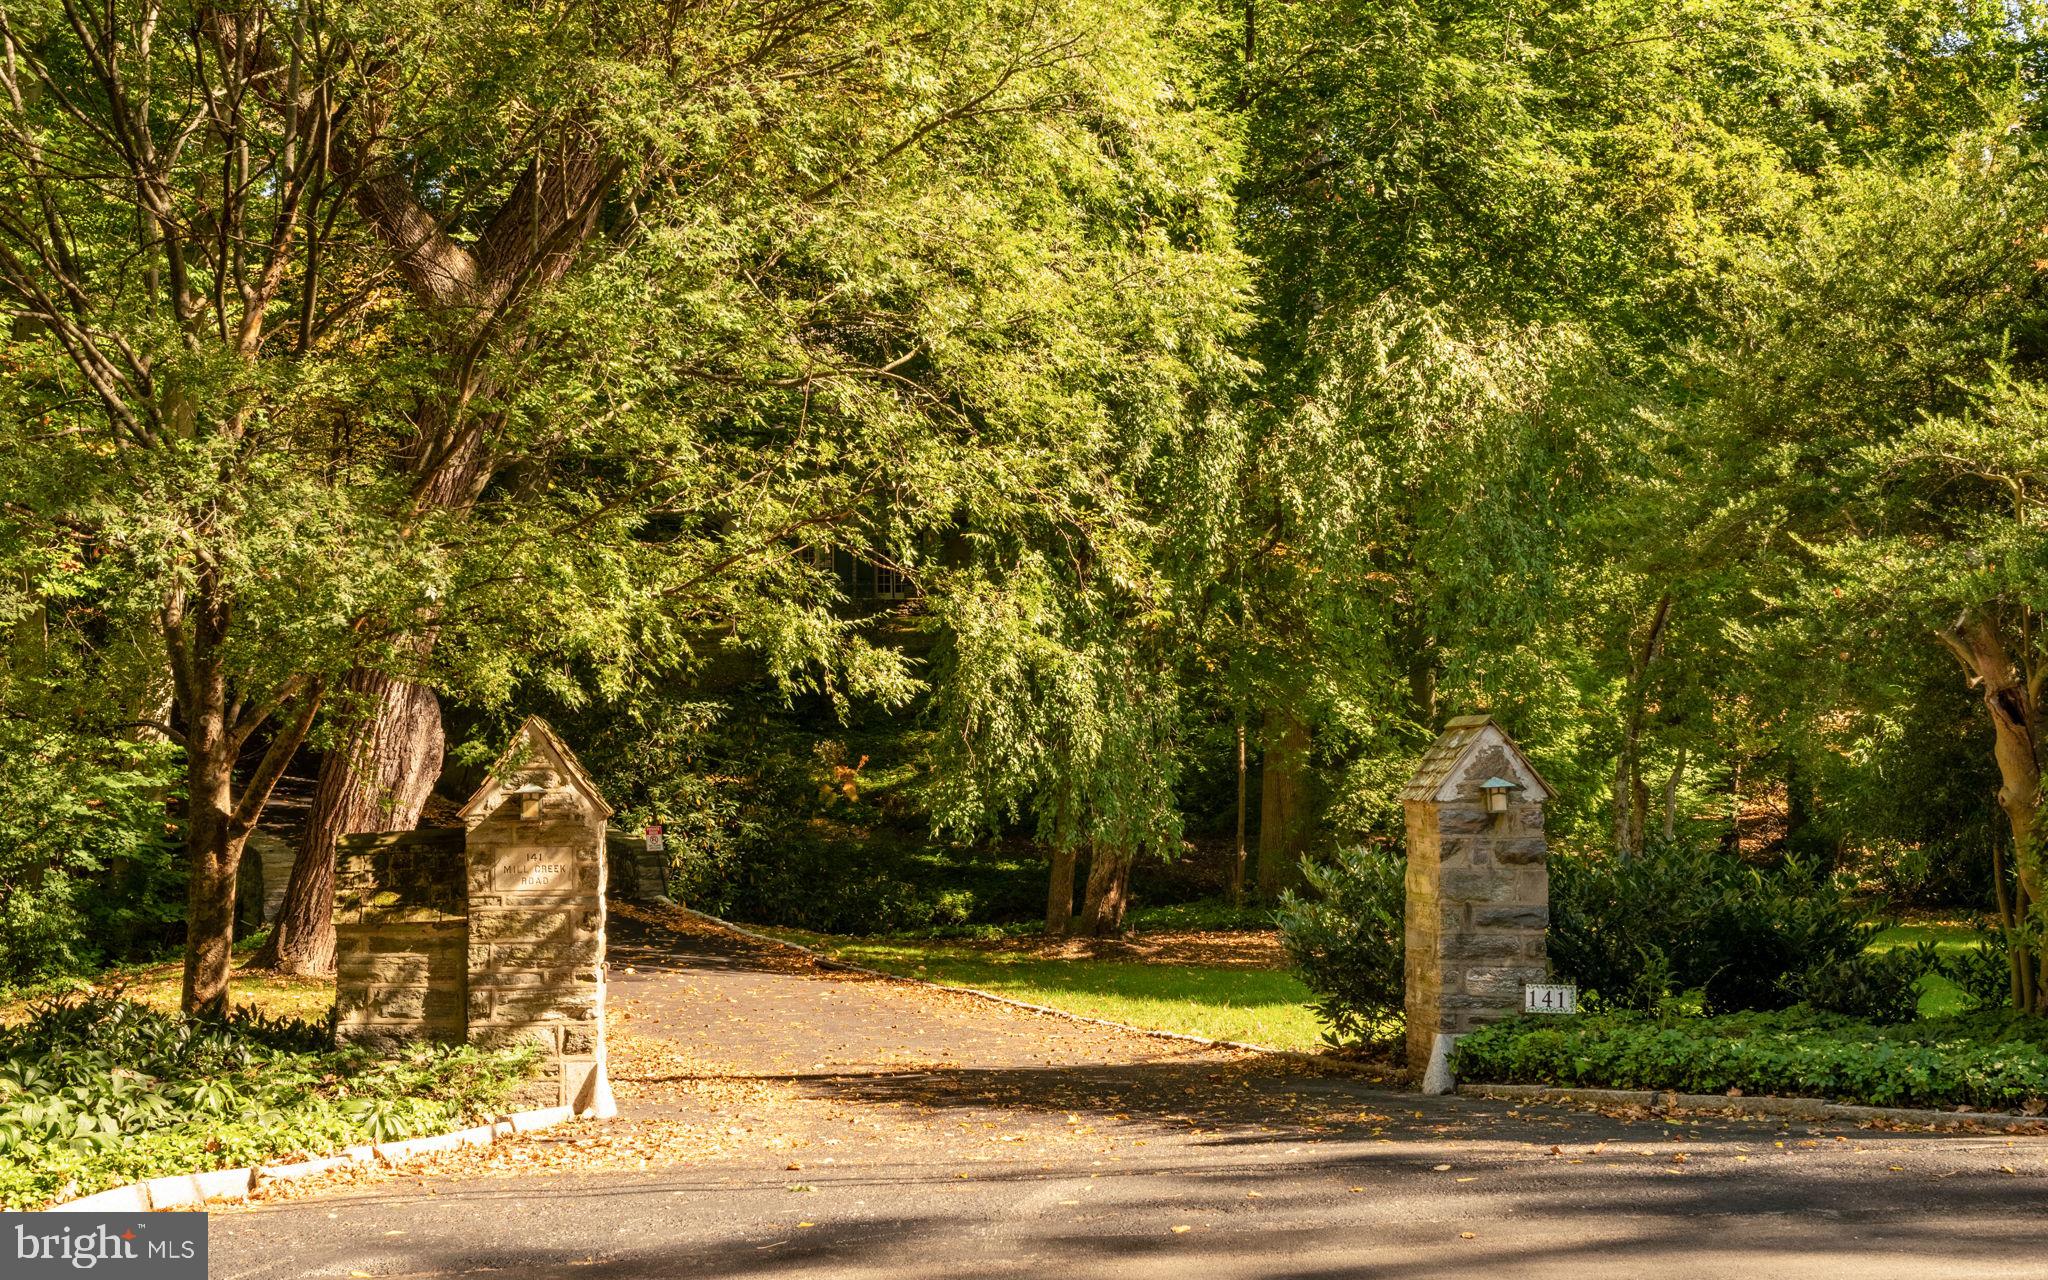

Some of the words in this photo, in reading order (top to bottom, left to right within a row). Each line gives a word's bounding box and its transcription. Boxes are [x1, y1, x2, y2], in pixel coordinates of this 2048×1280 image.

[526, 853, 542, 861] 141
[503, 865, 528, 874] MILL
[534, 864, 566, 873] CREEK
[521, 876, 548, 885] ROAD
[1530, 990, 1564, 1007] 141
